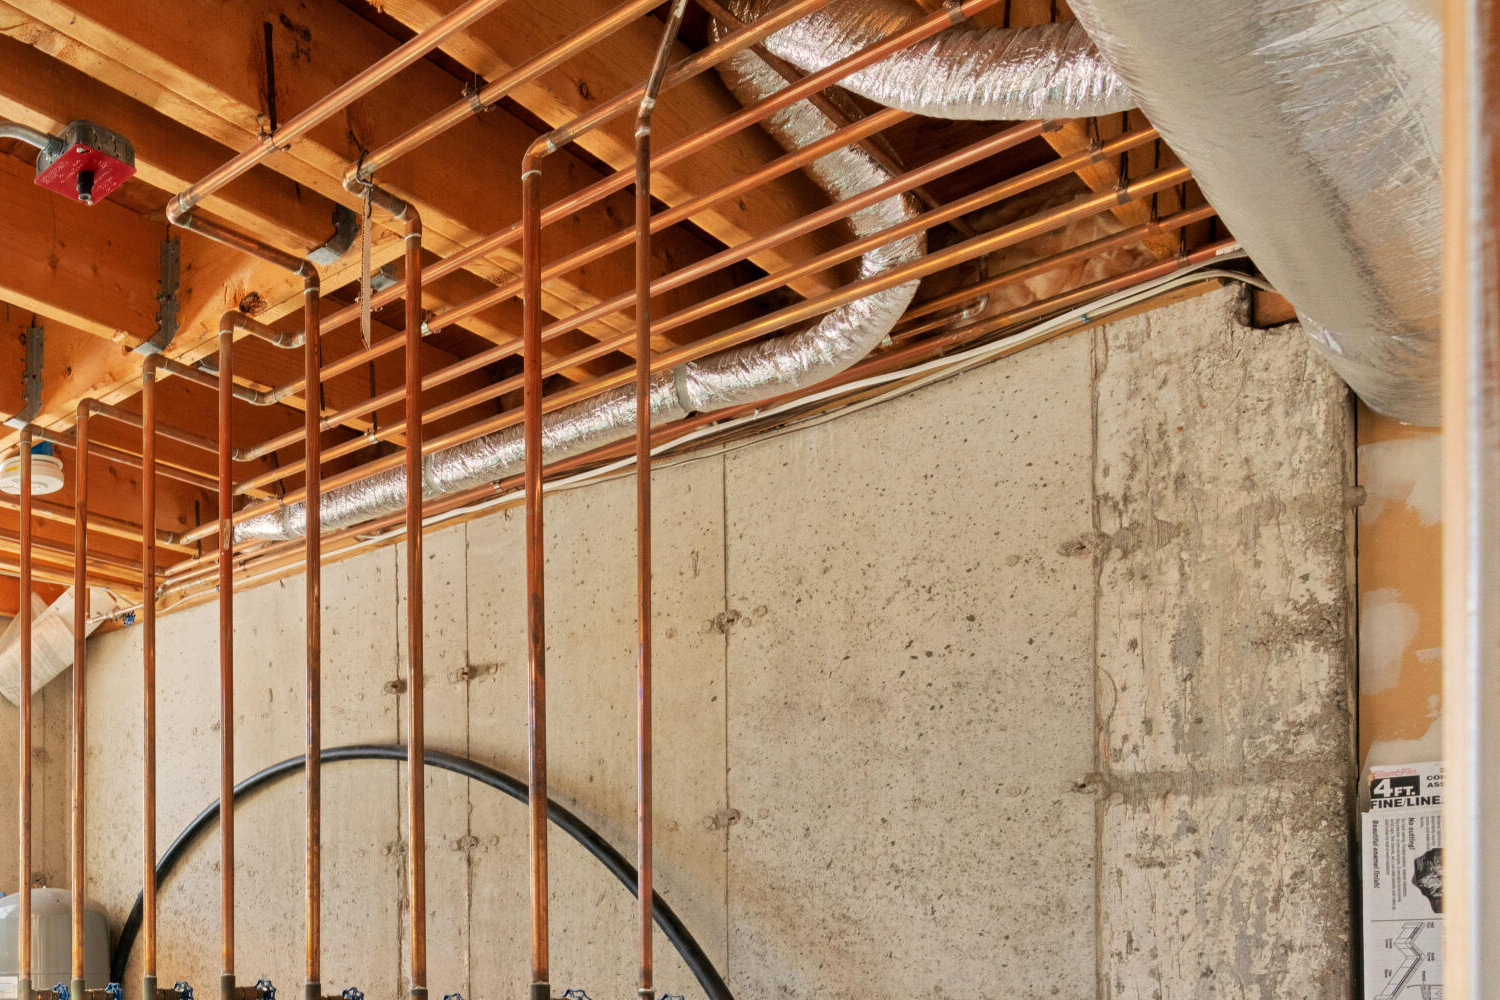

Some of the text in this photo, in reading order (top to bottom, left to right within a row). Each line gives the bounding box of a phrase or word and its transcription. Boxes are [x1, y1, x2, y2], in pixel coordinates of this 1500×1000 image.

[1374, 778, 1416, 798] 4 FT.
[1371, 796, 1441, 809] FINE/LINE
[1408, 817, 1415, 825] No
